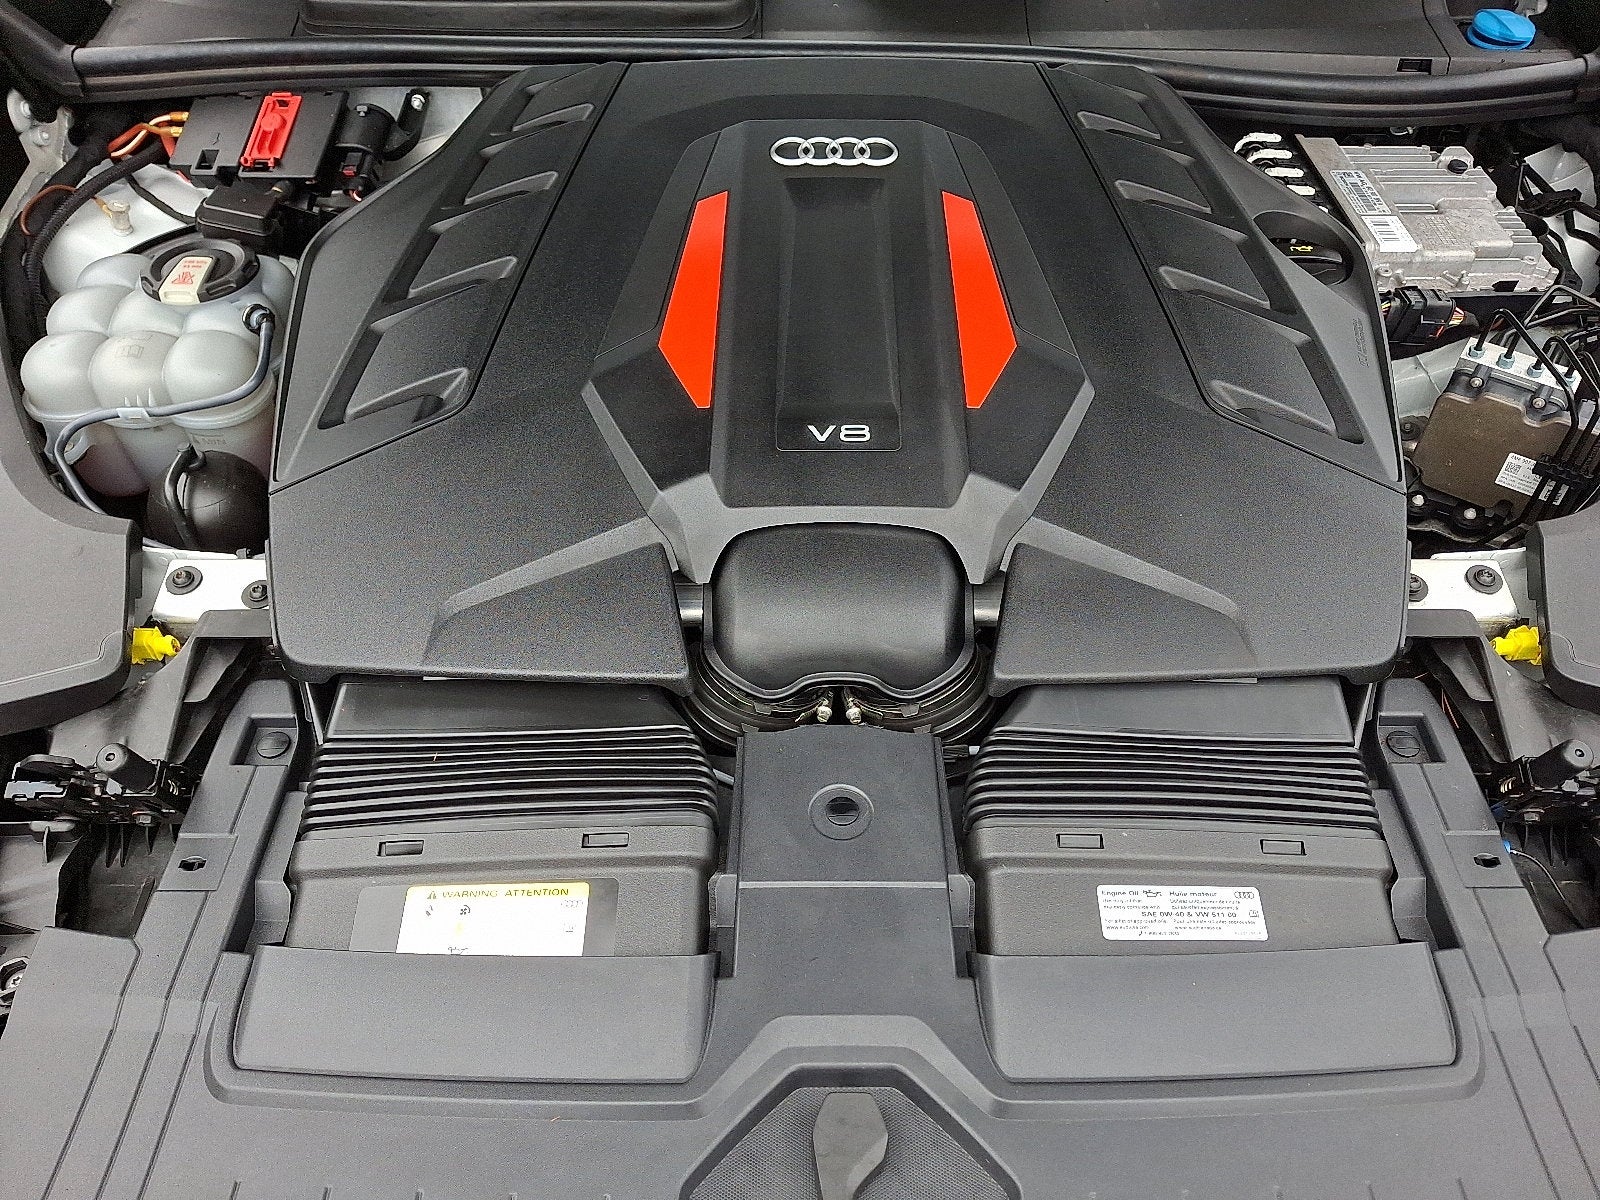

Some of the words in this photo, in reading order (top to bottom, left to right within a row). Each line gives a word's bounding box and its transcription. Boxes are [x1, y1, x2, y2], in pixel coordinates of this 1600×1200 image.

[806, 424, 871, 442] V8
[442, 890, 498, 898] WARNING
[505, 888, 569, 897] ATTENTION
